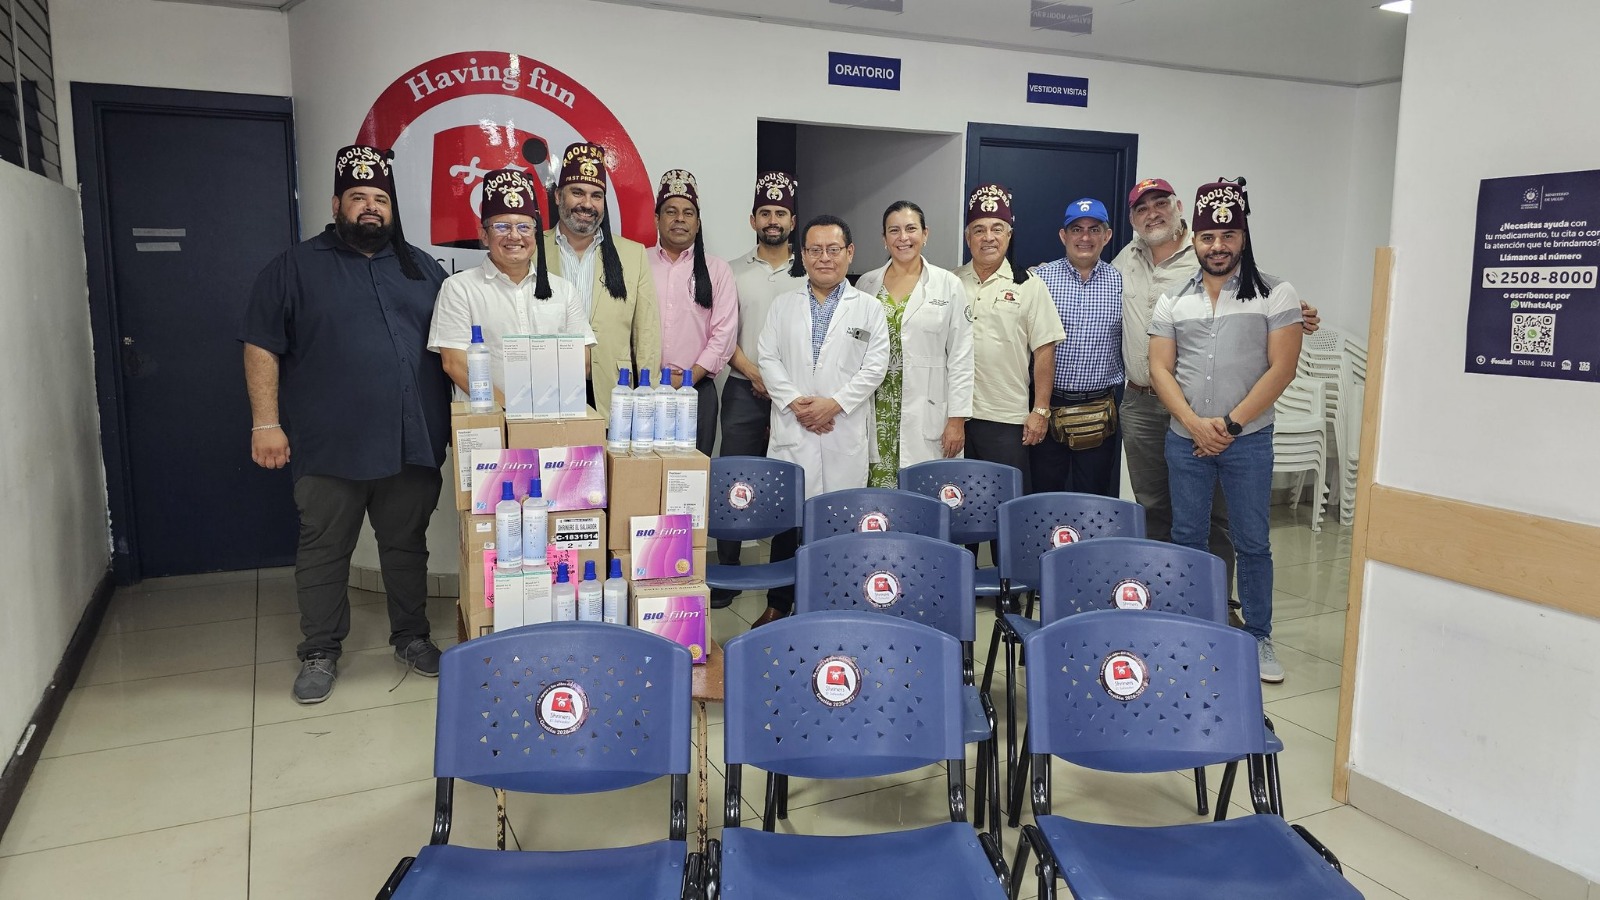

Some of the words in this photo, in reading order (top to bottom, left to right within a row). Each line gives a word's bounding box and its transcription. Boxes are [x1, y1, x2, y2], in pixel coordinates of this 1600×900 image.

[835, 63, 895, 80] ORATORIO
[404, 57, 521, 102] Having
[527, 67, 577, 109] fun
[1029, 84, 1062, 94] VESTIDOR
[1063, 87, 1087, 96] VISITAS
[1500, 221, 1542, 231] ¿Necesitas
[1543, 220, 1569, 229] ayuda
[1495, 231, 1549, 240] medicamento,
[1561, 230, 1577, 238] cita
[1492, 241, 1525, 249] atención
[1526, 242, 1542, 250] que
[1500, 253, 1538, 261] Llámanos
[1548, 252, 1582, 260] número
[1500, 271, 1593, 284] 2508-8000
[1520, 301, 1563, 310] WhatsApp
[1517, 359, 1535, 367] ISBM
[1540, 360, 1556, 368] ISRI
[556, 533, 598, 541] C-1831914
